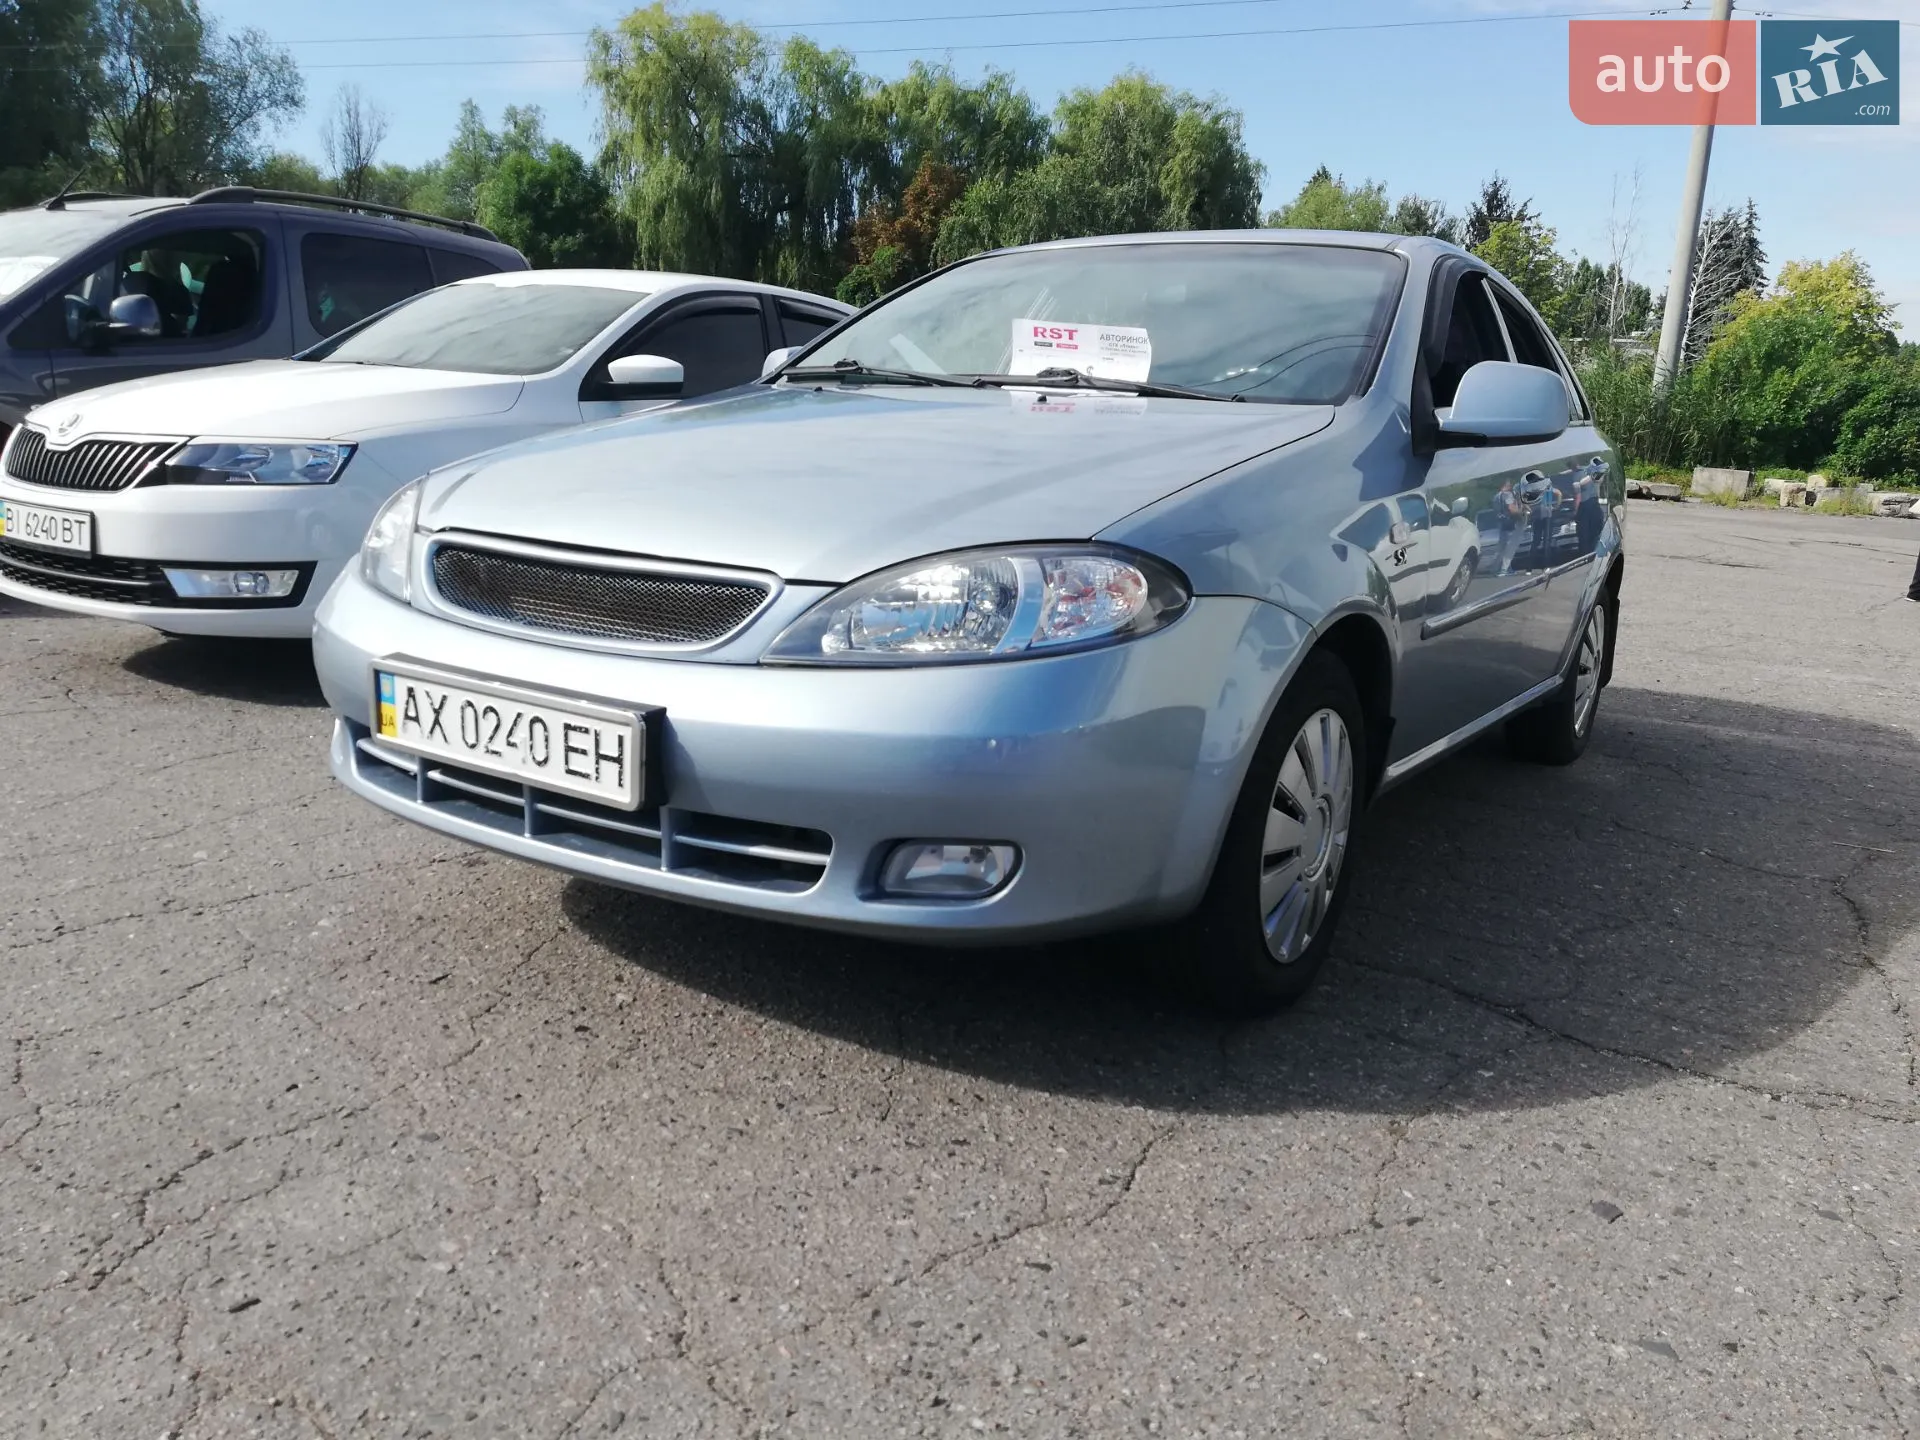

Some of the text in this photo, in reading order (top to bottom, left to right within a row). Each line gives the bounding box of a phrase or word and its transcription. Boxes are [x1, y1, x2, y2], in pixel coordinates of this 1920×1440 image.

[1033, 326, 1078, 340] RST
[1100, 333, 1149, 345] АВТОРИНОК
[6, 507, 87, 546] BI 6240 BT
[382, 713, 396, 728] UA
[402, 685, 625, 788] AX 0240 EH
